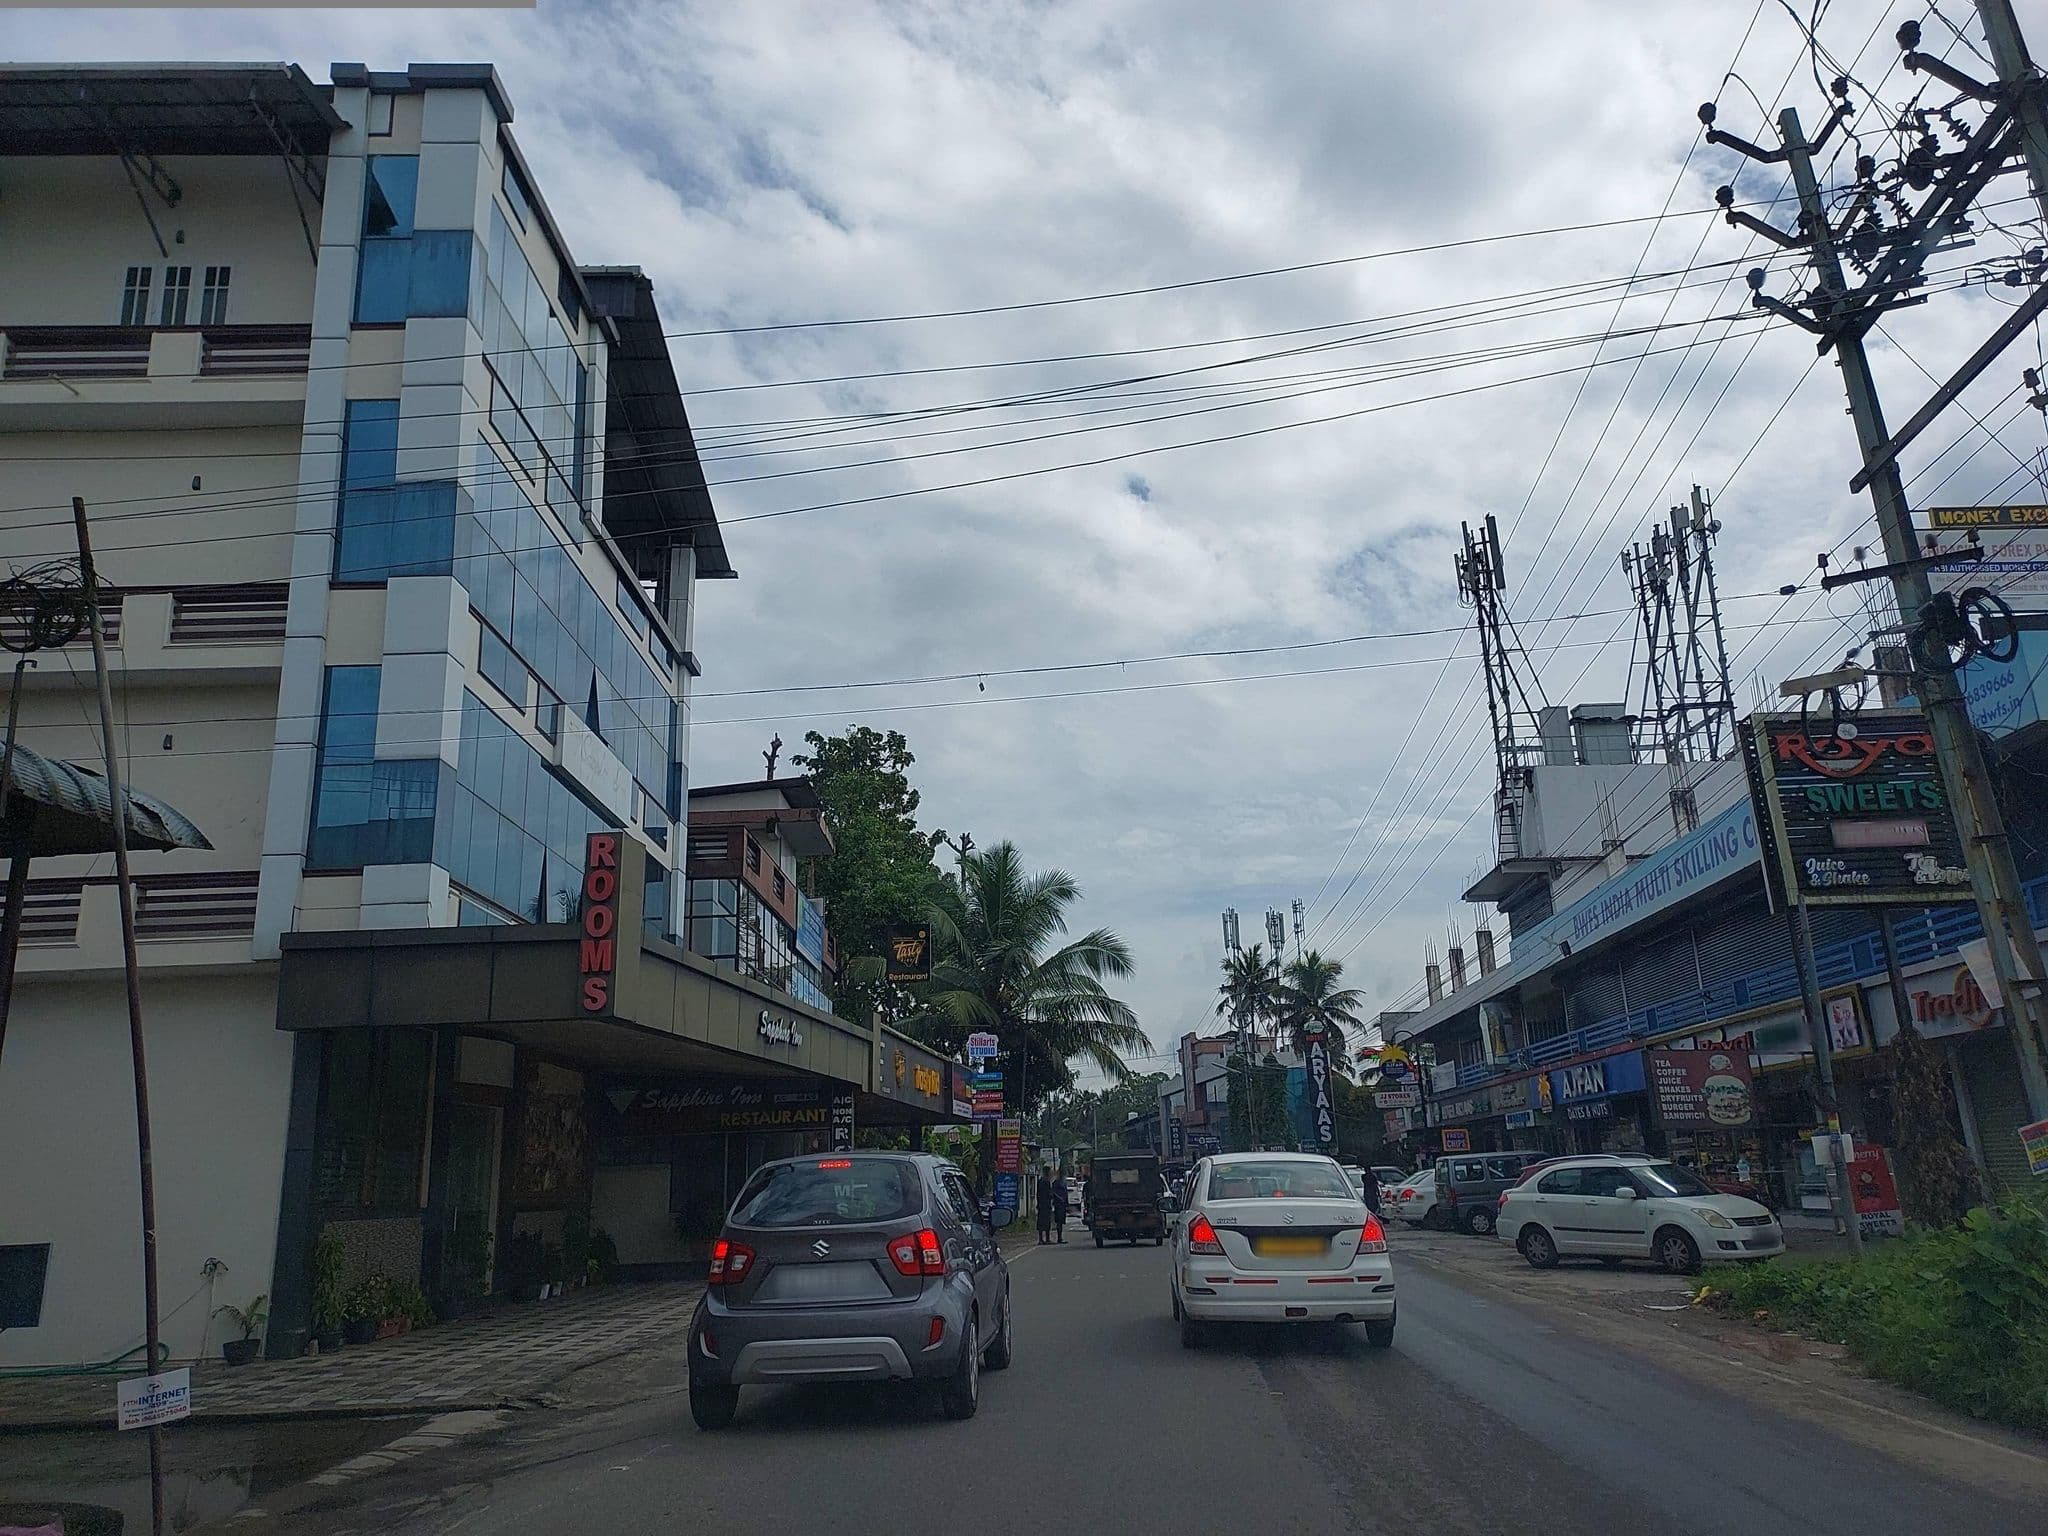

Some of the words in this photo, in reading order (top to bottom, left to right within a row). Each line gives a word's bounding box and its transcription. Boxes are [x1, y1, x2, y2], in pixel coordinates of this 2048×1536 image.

[1940, 510, 2000, 524] MONEY
[1775, 734, 1935, 778] Roya
[1806, 782, 1941, 815] SWEETS
[1806, 858, 1845, 874] Juice
[1601, 888, 1634, 925] INDIA
[1635, 863, 1672, 908] MULTI
[1675, 826, 1740, 888] SKILLING
[1823, 871, 1871, 886] Shake
[580, 834, 616, 1011] ROOMS
[893, 941, 922, 964] Tasty
[889, 972, 928, 981] Restaurant
[971, 1047, 996, 1055] STUDIO
[643, 1088, 724, 1112] Sapphire
[730, 1086, 762, 1105] Inn
[1310, 1041, 1332, 1142] ARYAAS
[1662, 1103, 1695, 1111] BURGER
[720, 1109, 828, 1127] RESTAURANT
[833, 1116, 853, 1124] A/C
[1861, 1211, 1892, 1220] ROYAL
[1859, 1219, 1898, 1231] SWEETS
[138, 1387, 188, 1406] INTERNET
